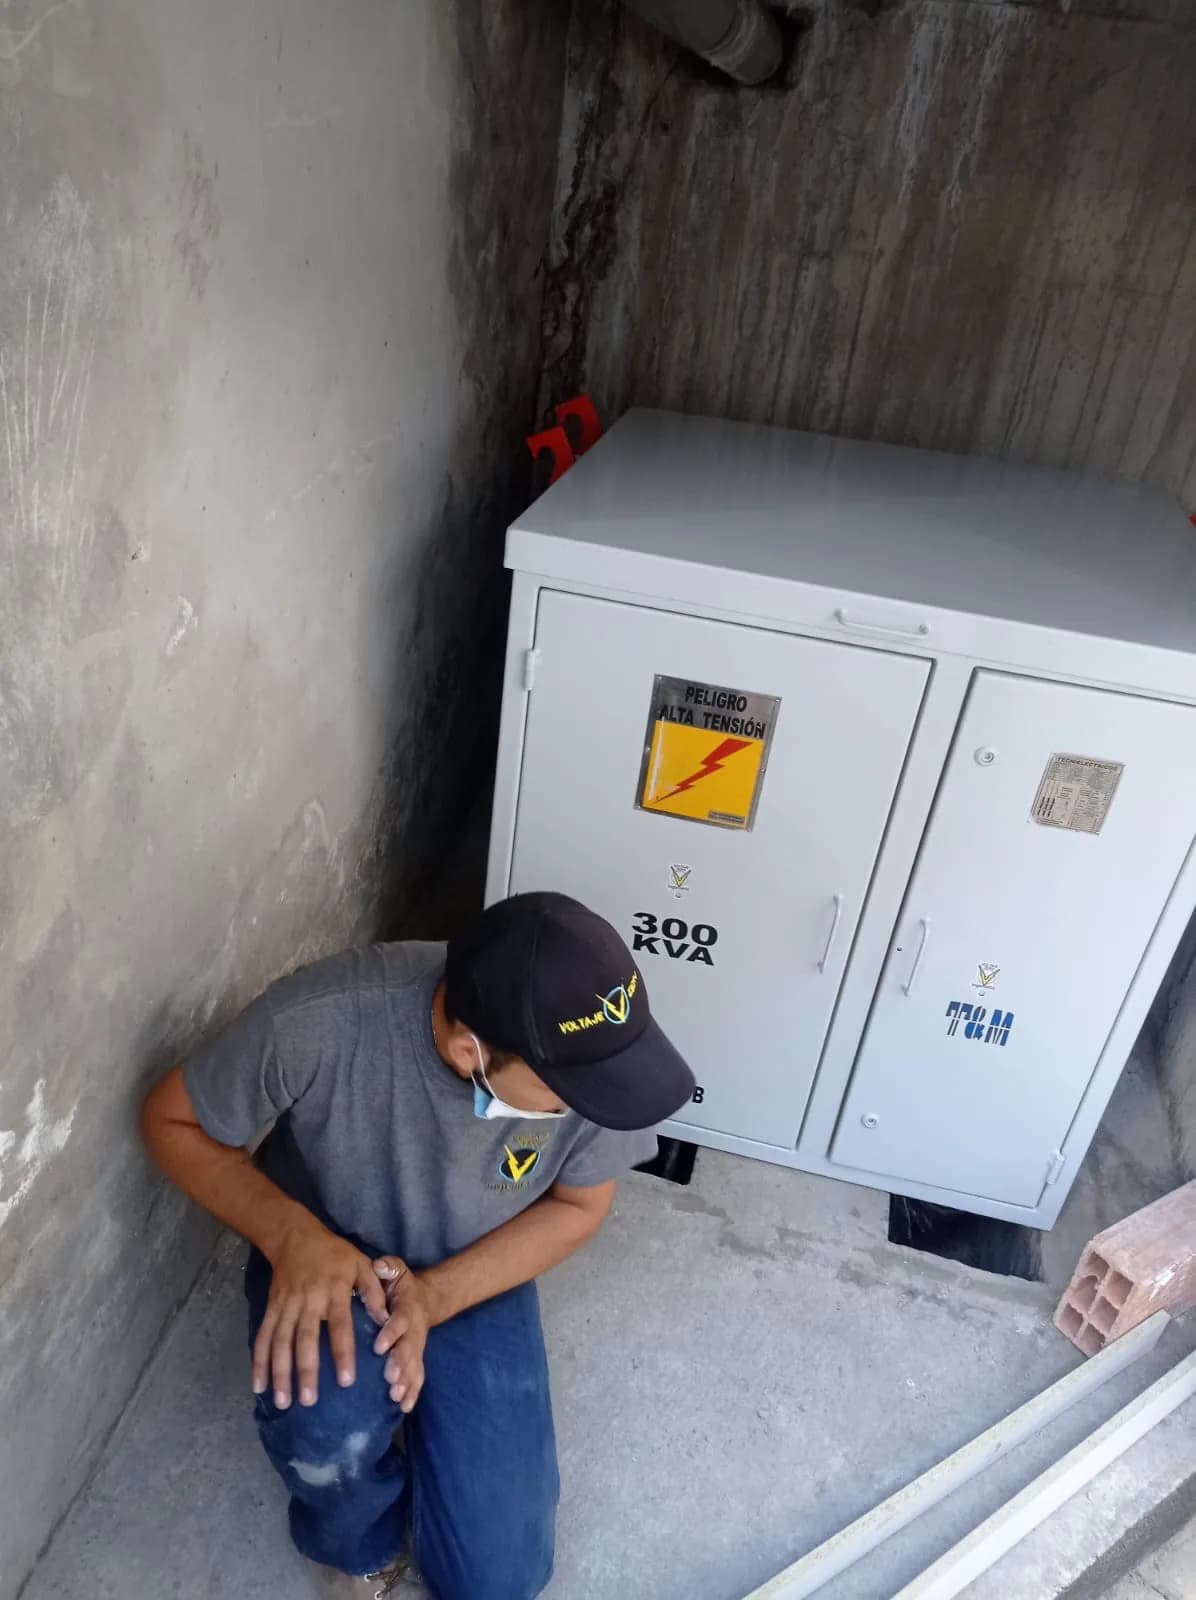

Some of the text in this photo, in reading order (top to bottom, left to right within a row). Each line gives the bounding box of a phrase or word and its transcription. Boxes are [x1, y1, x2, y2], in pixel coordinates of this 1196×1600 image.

[685, 687, 748, 713] PELIGRO
[659, 704, 766, 740] ALTA TENSIÓN
[631, 911, 719, 947] 300
[632, 933, 715, 967] KVA
[558, 1011, 605, 1035] VOLTAJE
